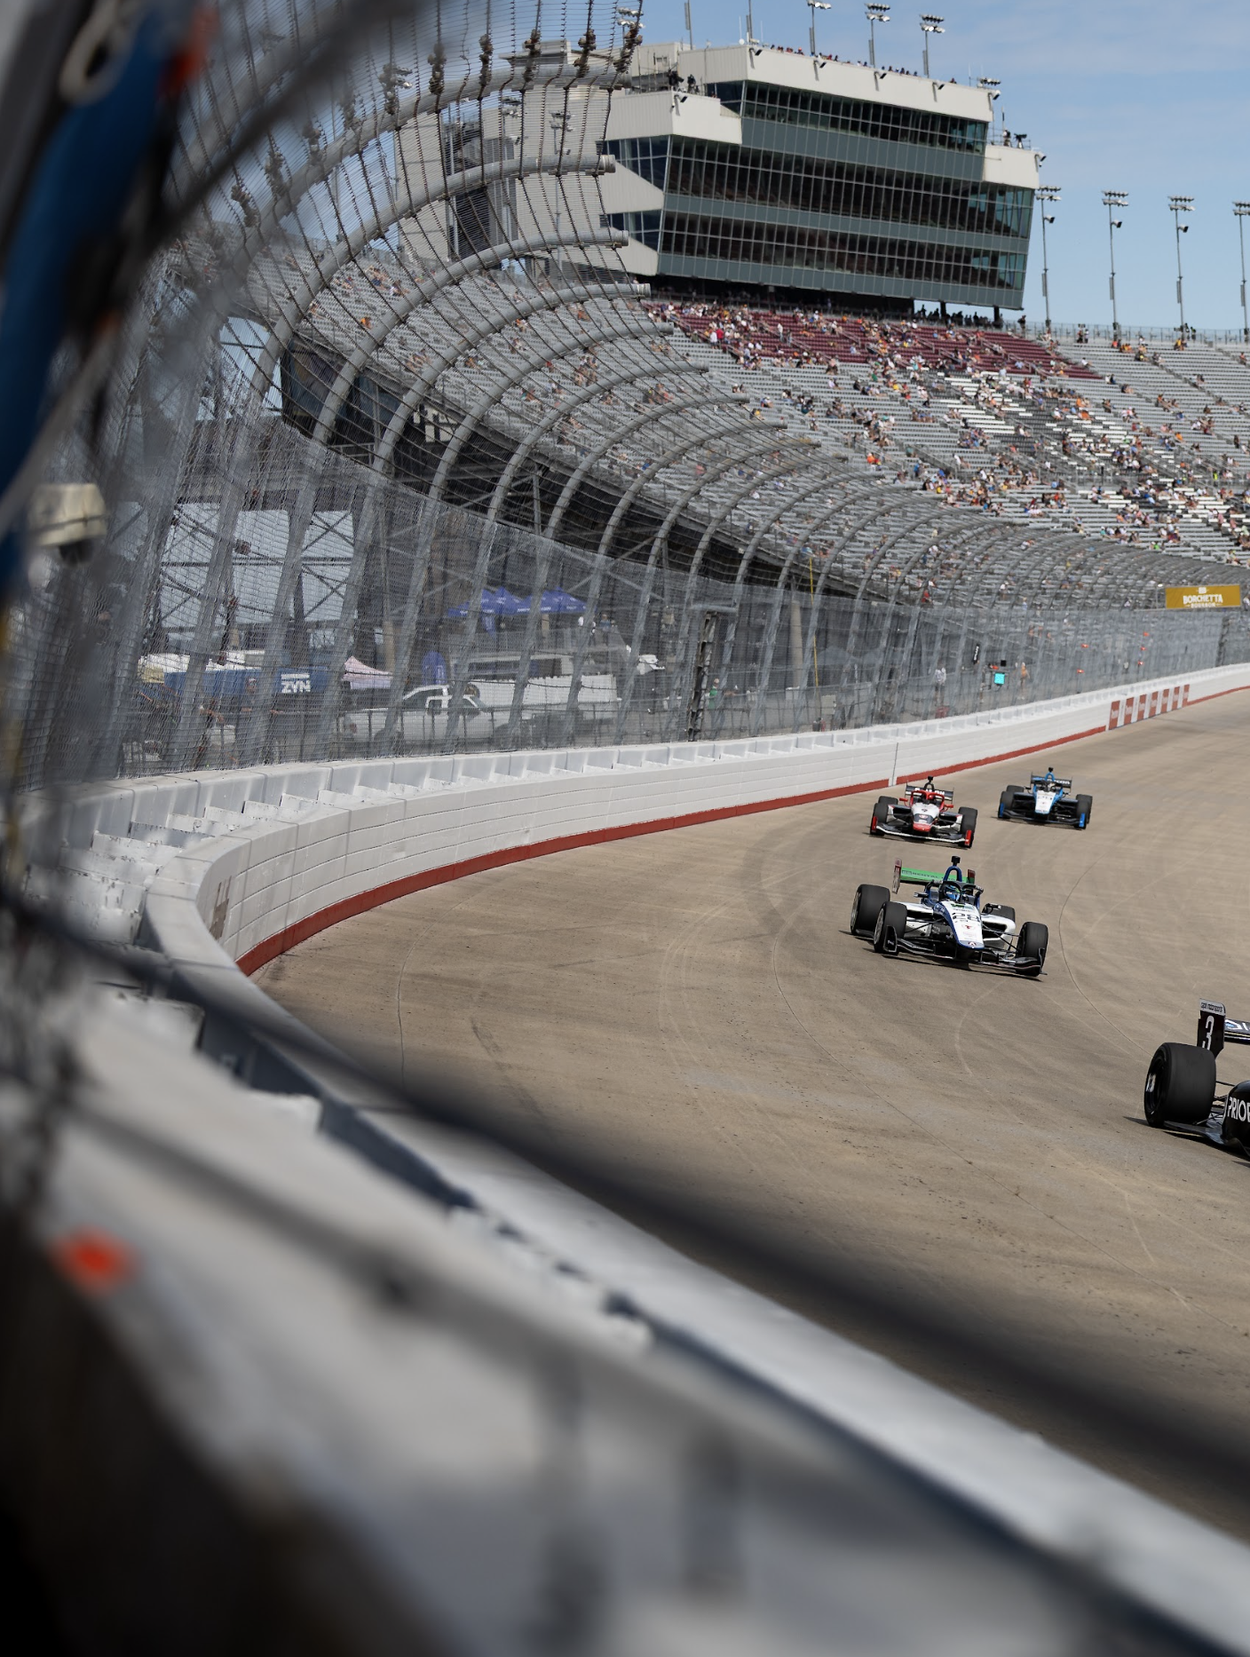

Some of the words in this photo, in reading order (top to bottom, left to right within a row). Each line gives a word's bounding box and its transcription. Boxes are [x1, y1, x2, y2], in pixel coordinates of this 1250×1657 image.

[1183, 594, 1223, 605] BORCHETTA
[281, 680, 311, 693] ZYN
[1201, 1015, 1214, 1051] 3
